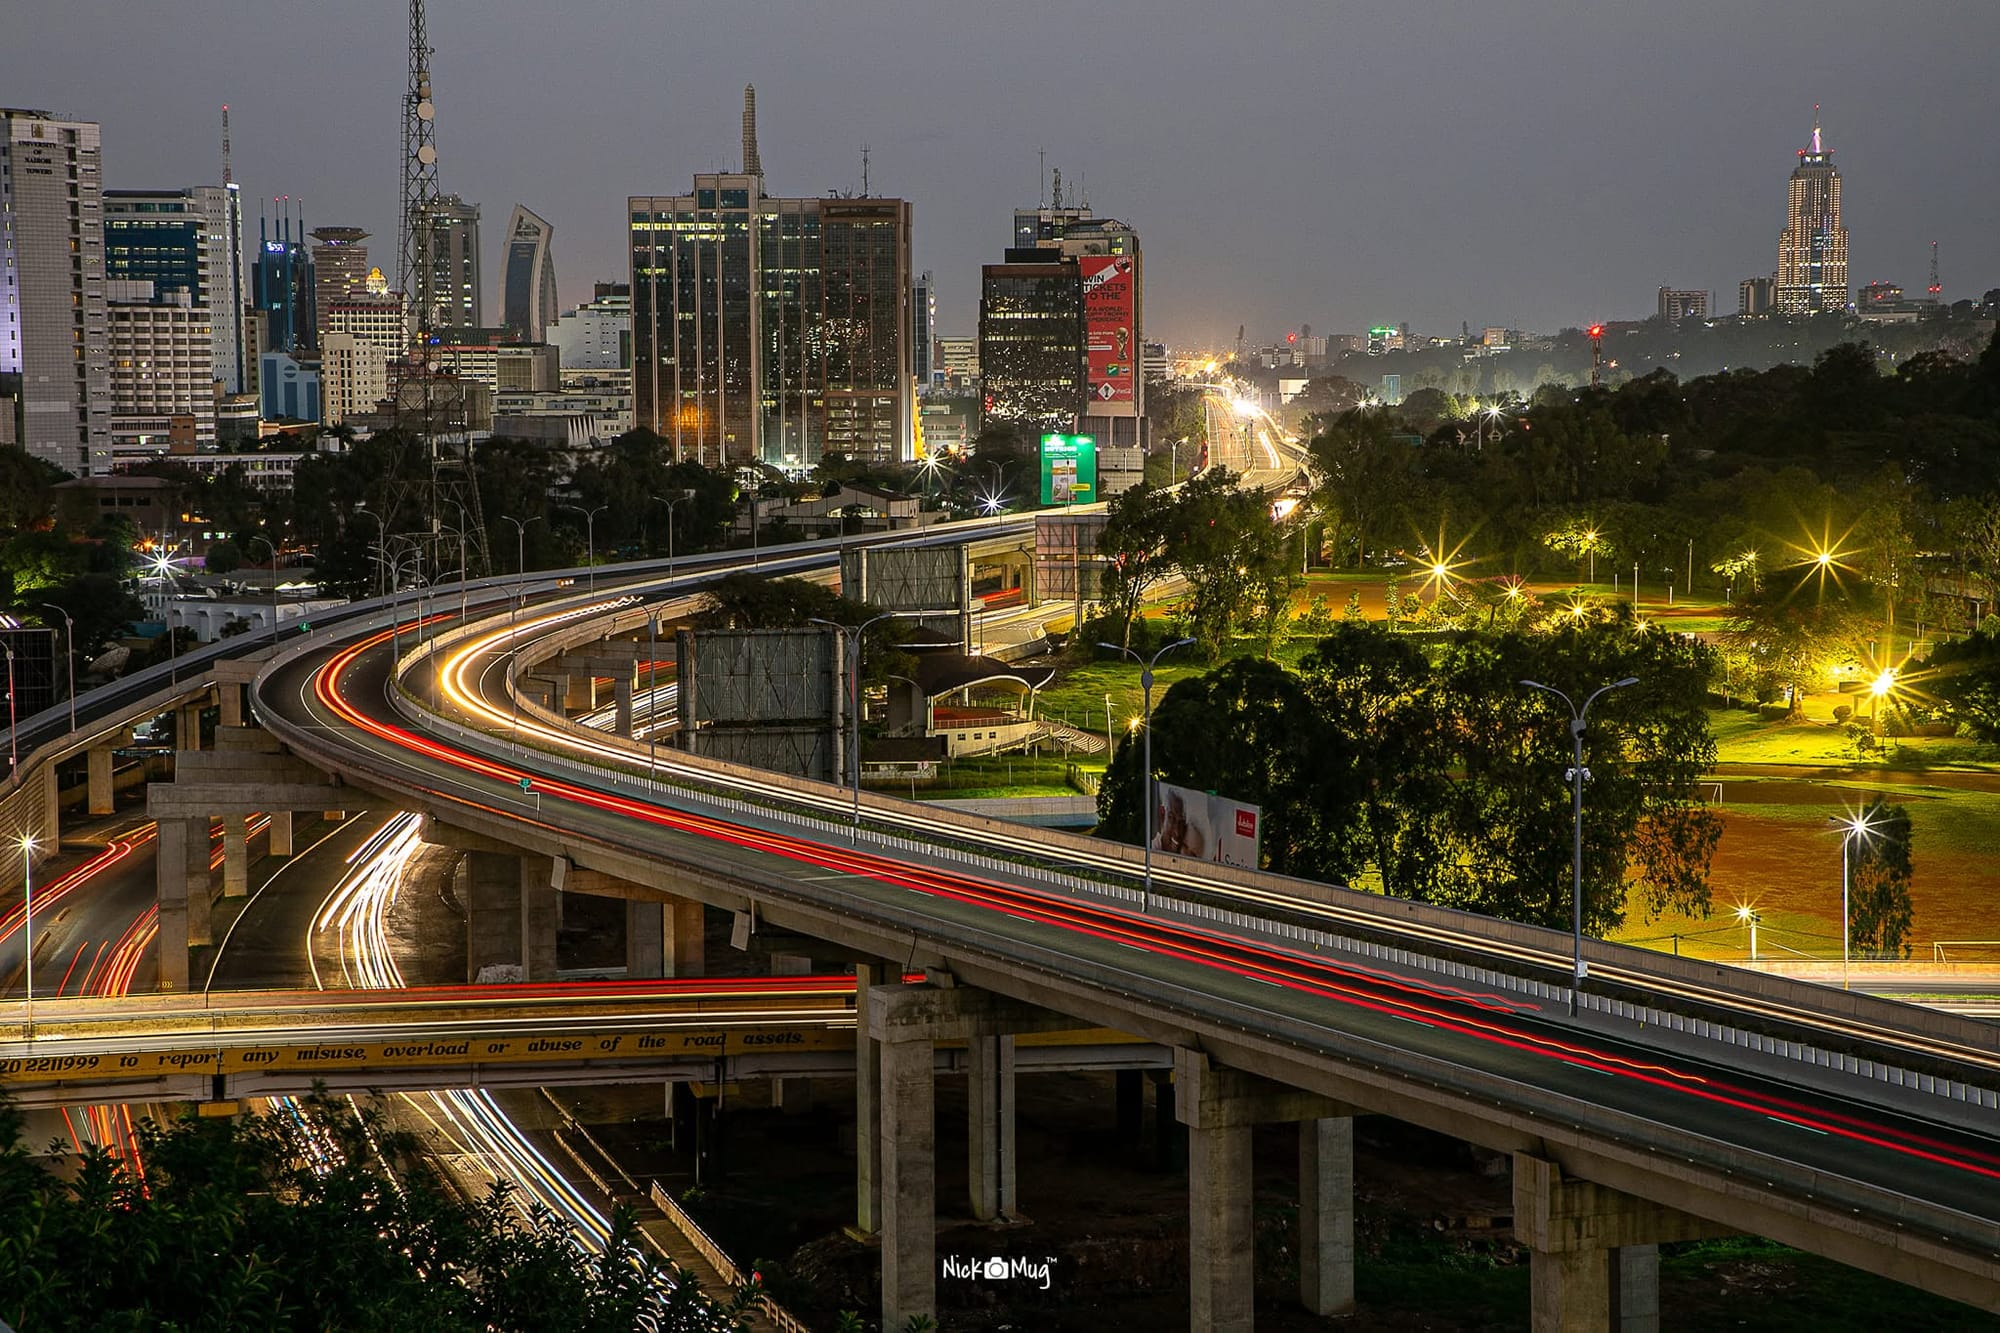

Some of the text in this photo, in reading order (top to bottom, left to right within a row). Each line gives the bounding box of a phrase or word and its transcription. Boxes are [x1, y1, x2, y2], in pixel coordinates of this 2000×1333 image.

[18, 140, 56, 148] UNIVERSITY
[1084, 274, 1105, 283] WIN
[1102, 292, 1121, 300] THE
[25, 1056, 99, 1072] 2211999
[120, 1055, 139, 1067] to
[158, 1051, 224, 1069] report
[242, 1051, 280, 1065] any
[297, 1046, 367, 1060] misuse,
[383, 1042, 470, 1058] overload
[487, 1042, 511, 1053] or
[527, 1039, 583, 1052] abuse
[600, 1036, 622, 1052] of
[638, 1035, 666, 1048] the
[683, 1032, 727, 1047] road
[743, 1031, 805, 1045] assets.
